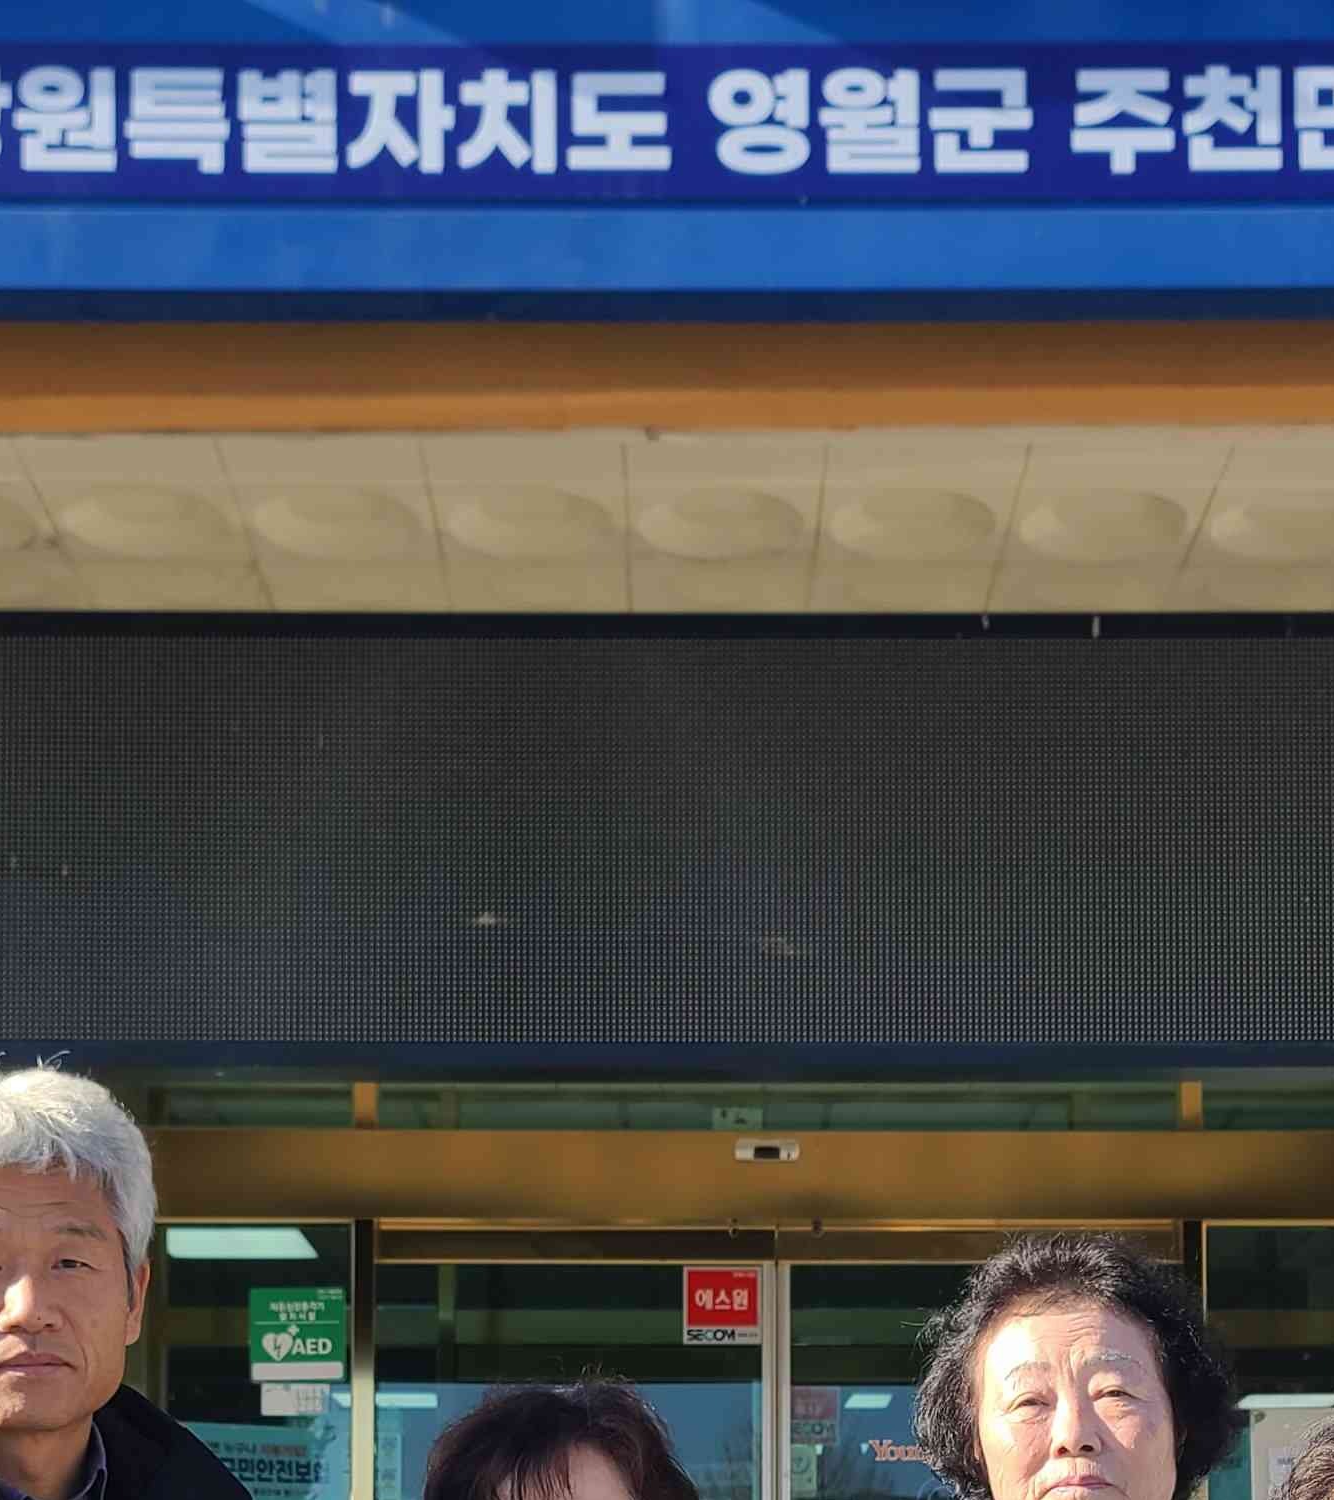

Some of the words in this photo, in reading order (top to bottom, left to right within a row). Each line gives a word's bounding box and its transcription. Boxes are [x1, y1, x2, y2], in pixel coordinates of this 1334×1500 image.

[707, 64, 1036, 175] 영월군
[695, 1288, 750, 1311] 에스원
[687, 1328, 736, 1341] SECOM
[291, 1338, 333, 1356] AED
